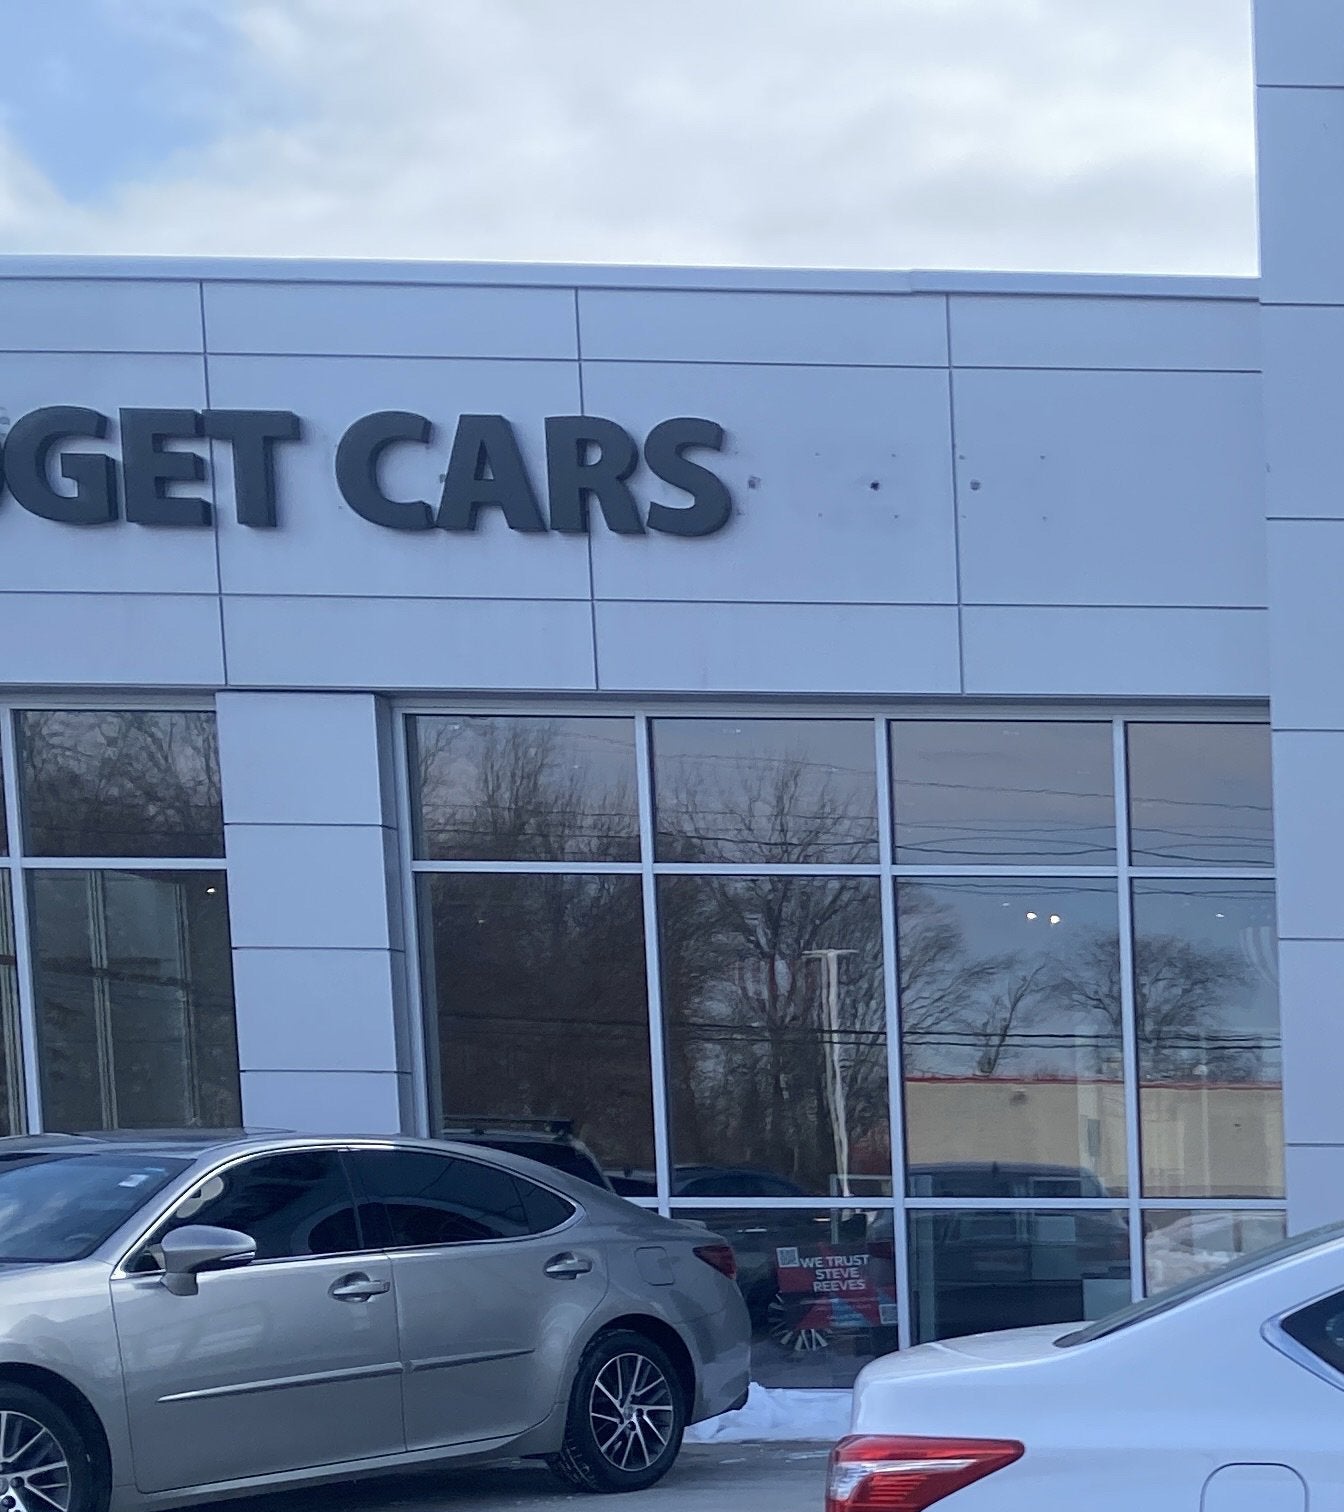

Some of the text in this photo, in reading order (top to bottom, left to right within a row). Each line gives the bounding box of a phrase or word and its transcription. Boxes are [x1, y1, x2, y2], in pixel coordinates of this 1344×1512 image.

[0, 404, 733, 537] GET CARS
[800, 1254, 870, 1268] WE TRUST
[815, 1267, 860, 1280] STEVE
[812, 1279, 866, 1292] REEVES
